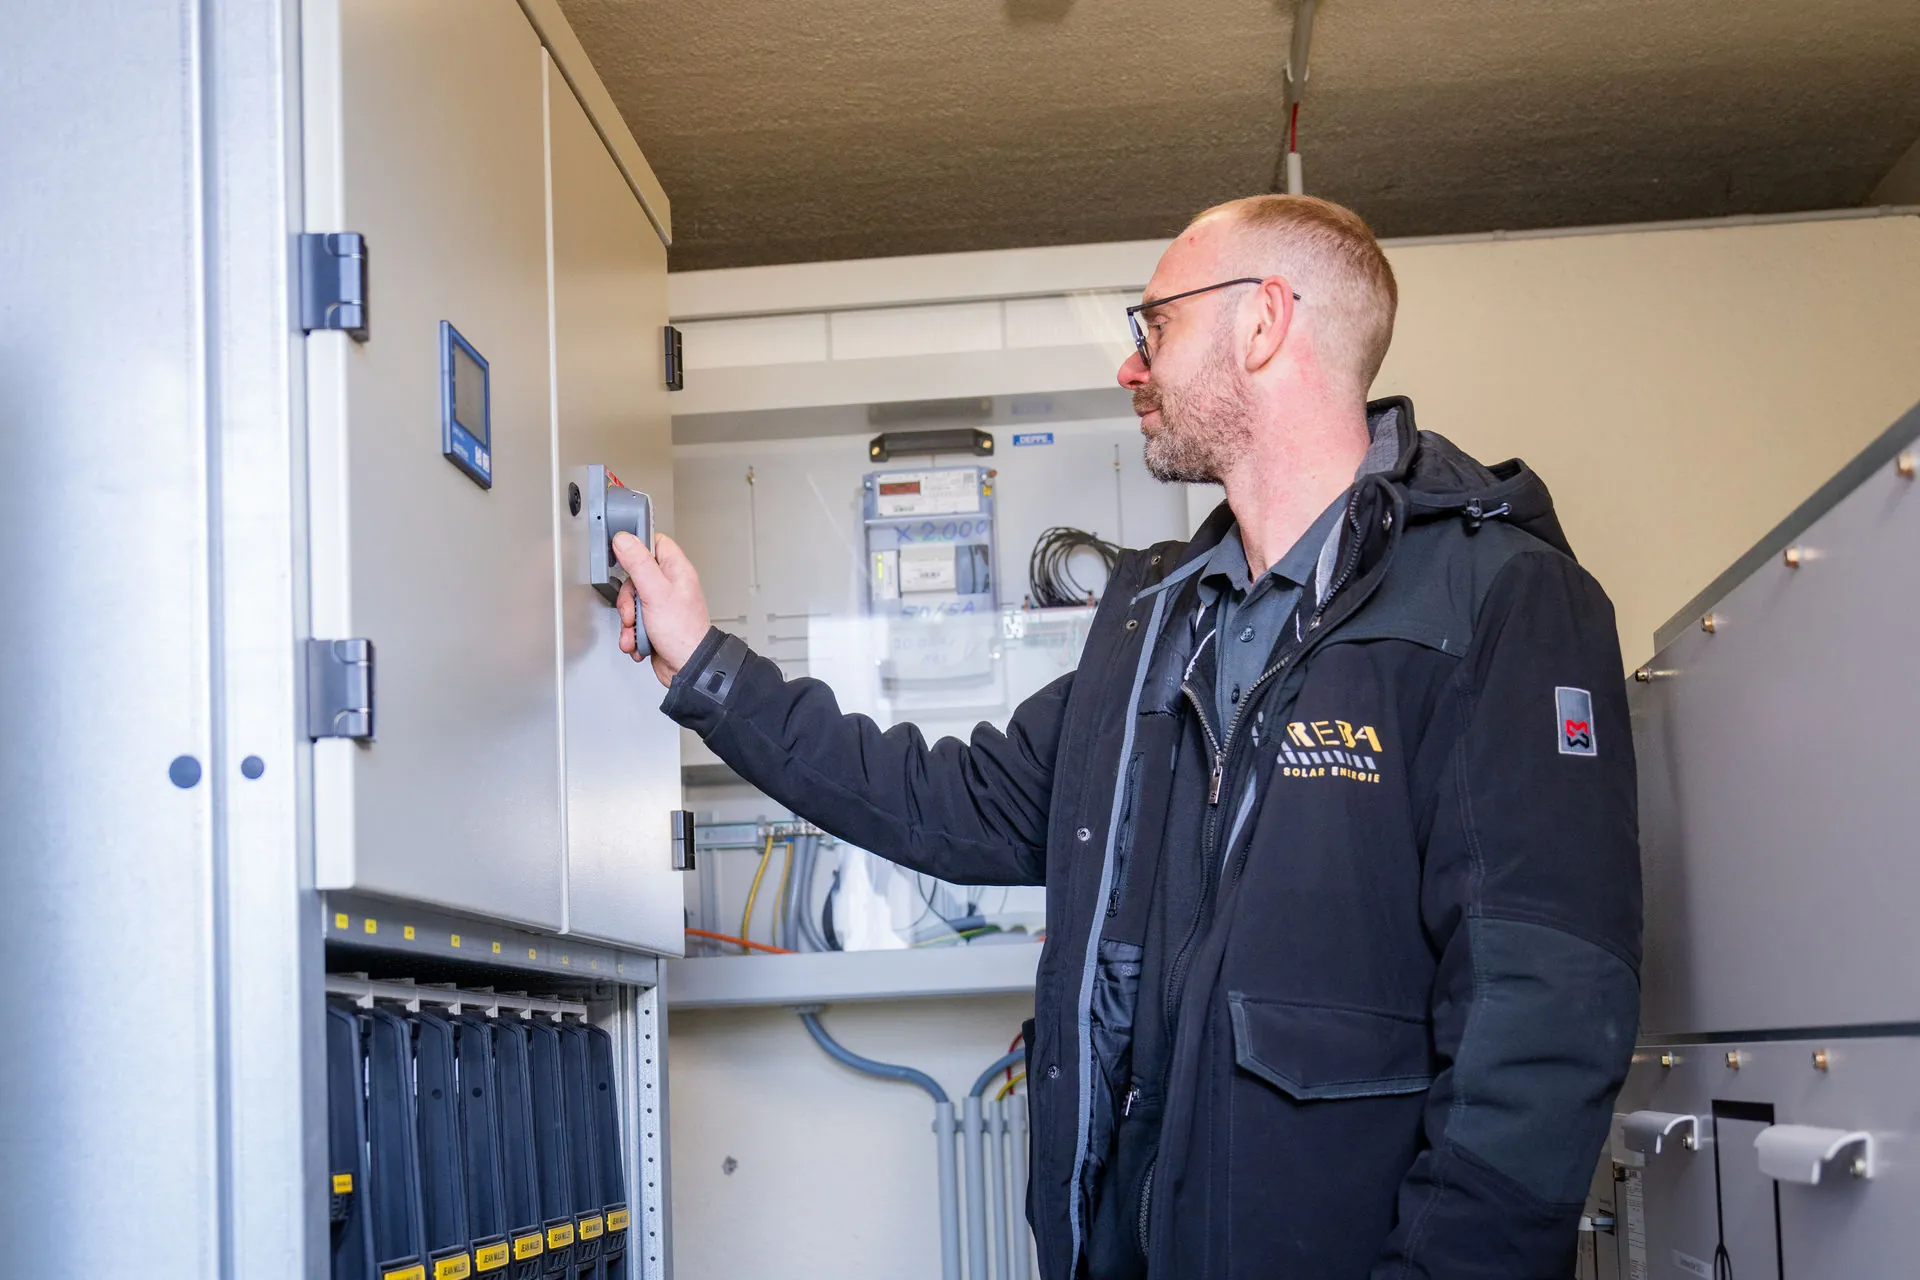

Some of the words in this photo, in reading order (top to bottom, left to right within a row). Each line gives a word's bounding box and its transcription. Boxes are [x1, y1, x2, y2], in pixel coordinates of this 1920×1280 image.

[1286, 719, 1383, 752] REBA
[1283, 766, 1325, 778] SOLAR
[1331, 766, 1381, 783] ENERGIE
